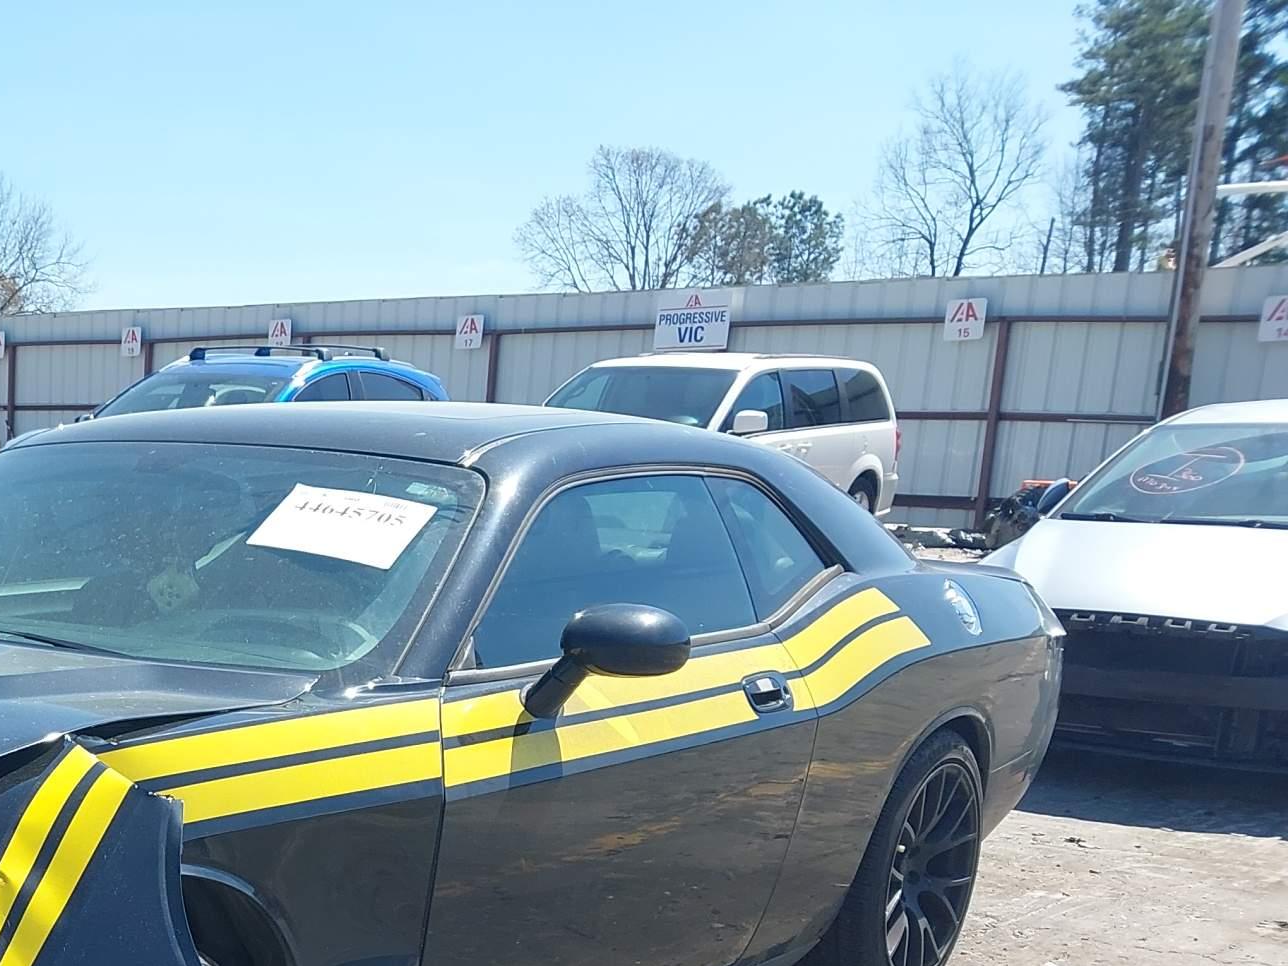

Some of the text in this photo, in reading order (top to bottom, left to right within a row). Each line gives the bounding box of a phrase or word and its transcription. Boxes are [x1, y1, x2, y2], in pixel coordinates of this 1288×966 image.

[658, 310, 727, 326] PROGRESSIVE
[677, 325, 705, 343] VIC
[957, 327, 970, 338] 15
[464, 338, 473, 347] 17
[294, 501, 407, 526] 44645705
